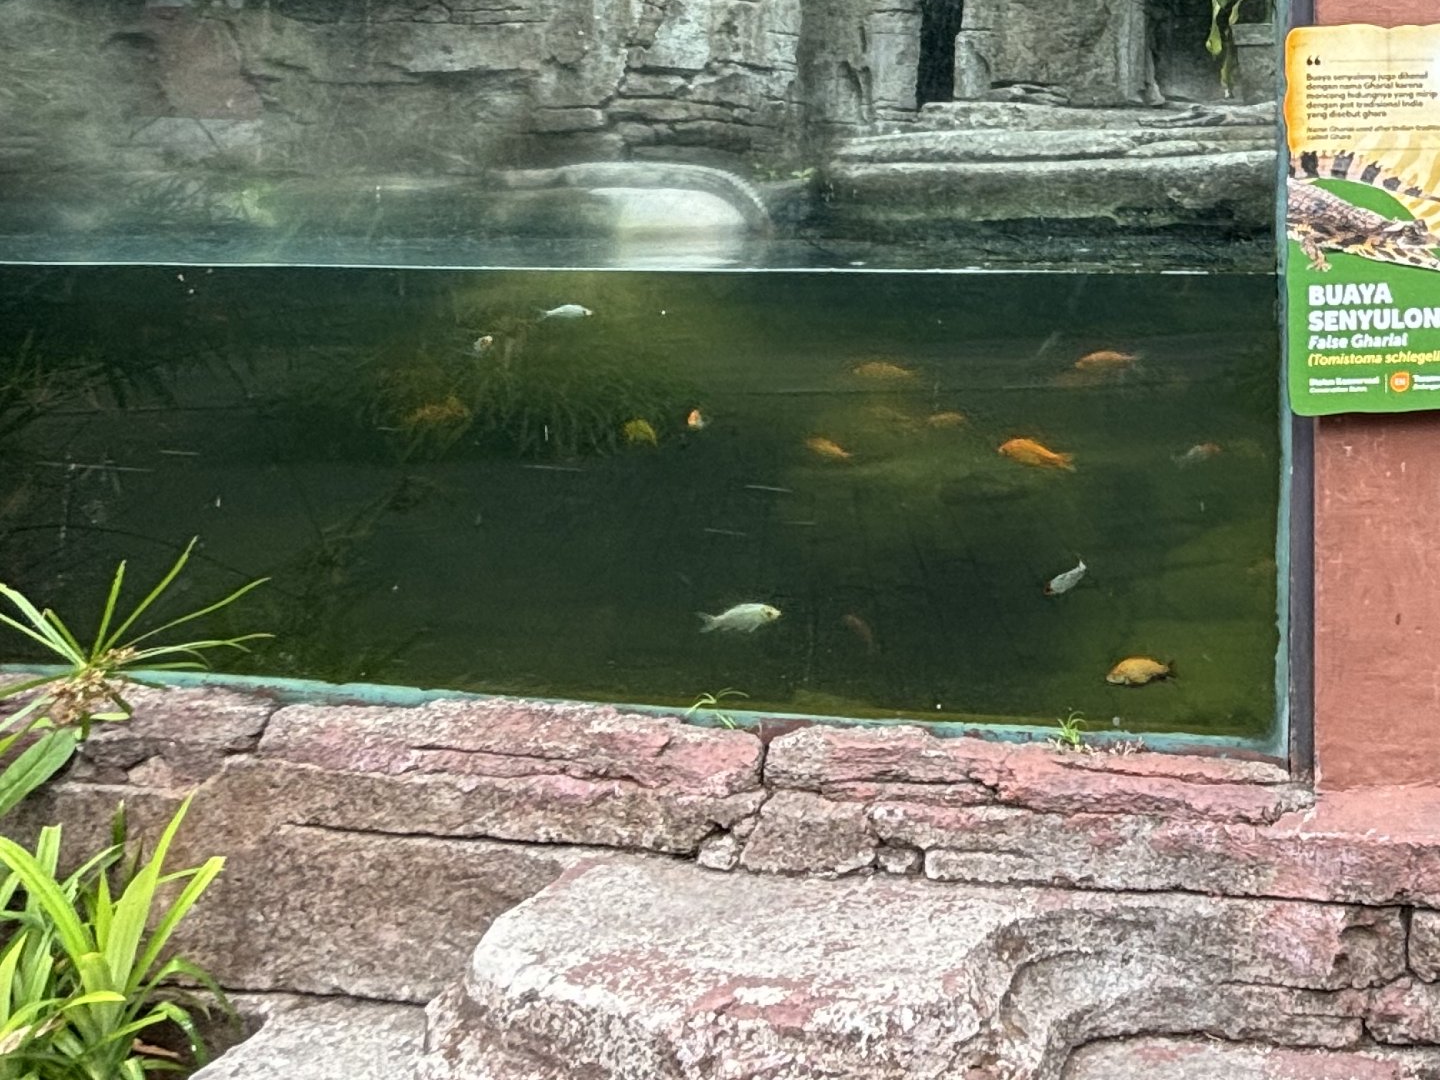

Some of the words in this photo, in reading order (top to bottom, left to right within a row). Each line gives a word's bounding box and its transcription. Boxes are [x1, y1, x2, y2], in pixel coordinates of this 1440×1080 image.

[1377, 73, 1396, 81] juga
[1306, 83, 1338, 91] dengan
[1363, 81, 1394, 89] Gharial
[1395, 81, 1423, 89] karena
[1306, 102, 1338, 110] dengan
[1306, 112, 1328, 120] yang
[1329, 110, 1361, 118] disebut
[1362, 110, 1387, 119] ghara
[1308, 282, 1393, 306] BUAYA
[1307, 334, 1348, 350] False
[1350, 332, 1408, 348] Gharial
[1307, 352, 1383, 367] (Tomistoma
